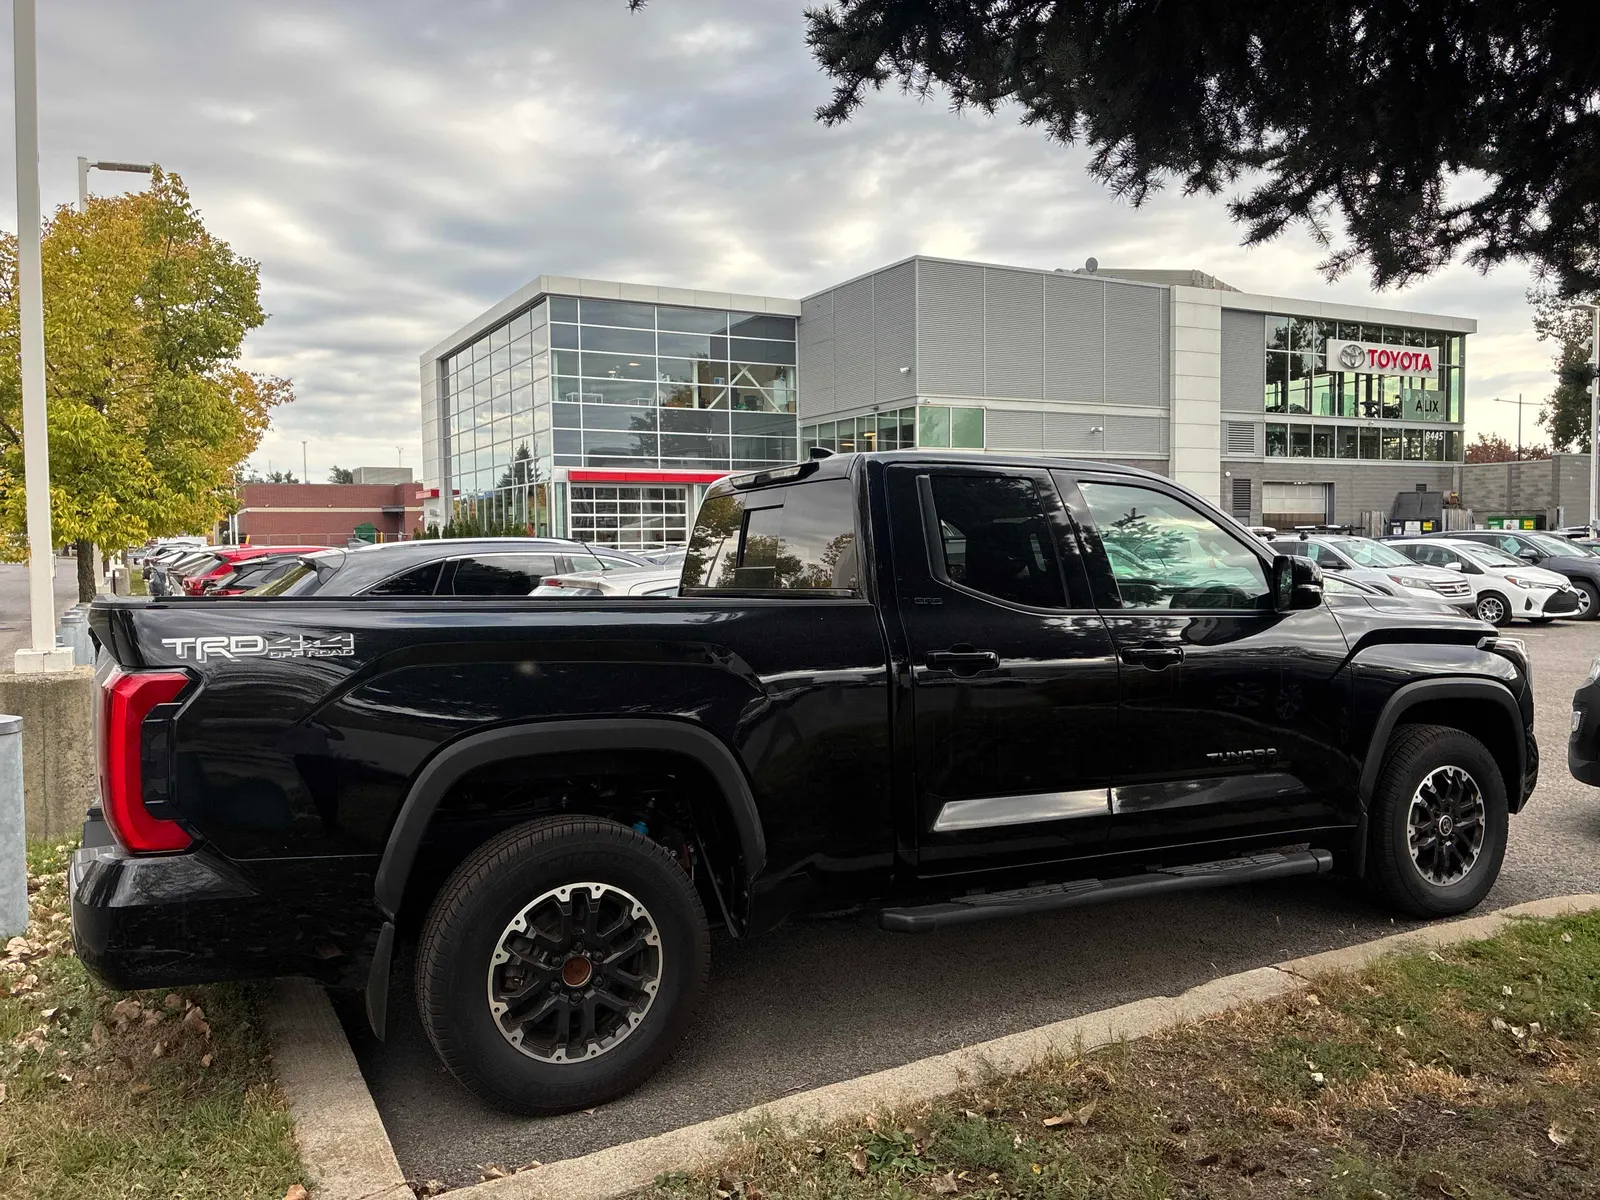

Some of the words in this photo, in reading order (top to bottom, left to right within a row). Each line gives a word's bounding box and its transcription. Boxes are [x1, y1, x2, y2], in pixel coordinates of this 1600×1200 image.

[1367, 349, 1432, 371] TOYOTA
[1415, 400, 1439, 412] ALIX
[1425, 431, 1443, 440] 8445
[162, 635, 268, 663] TRD
[307, 649, 354, 658] ROAD
